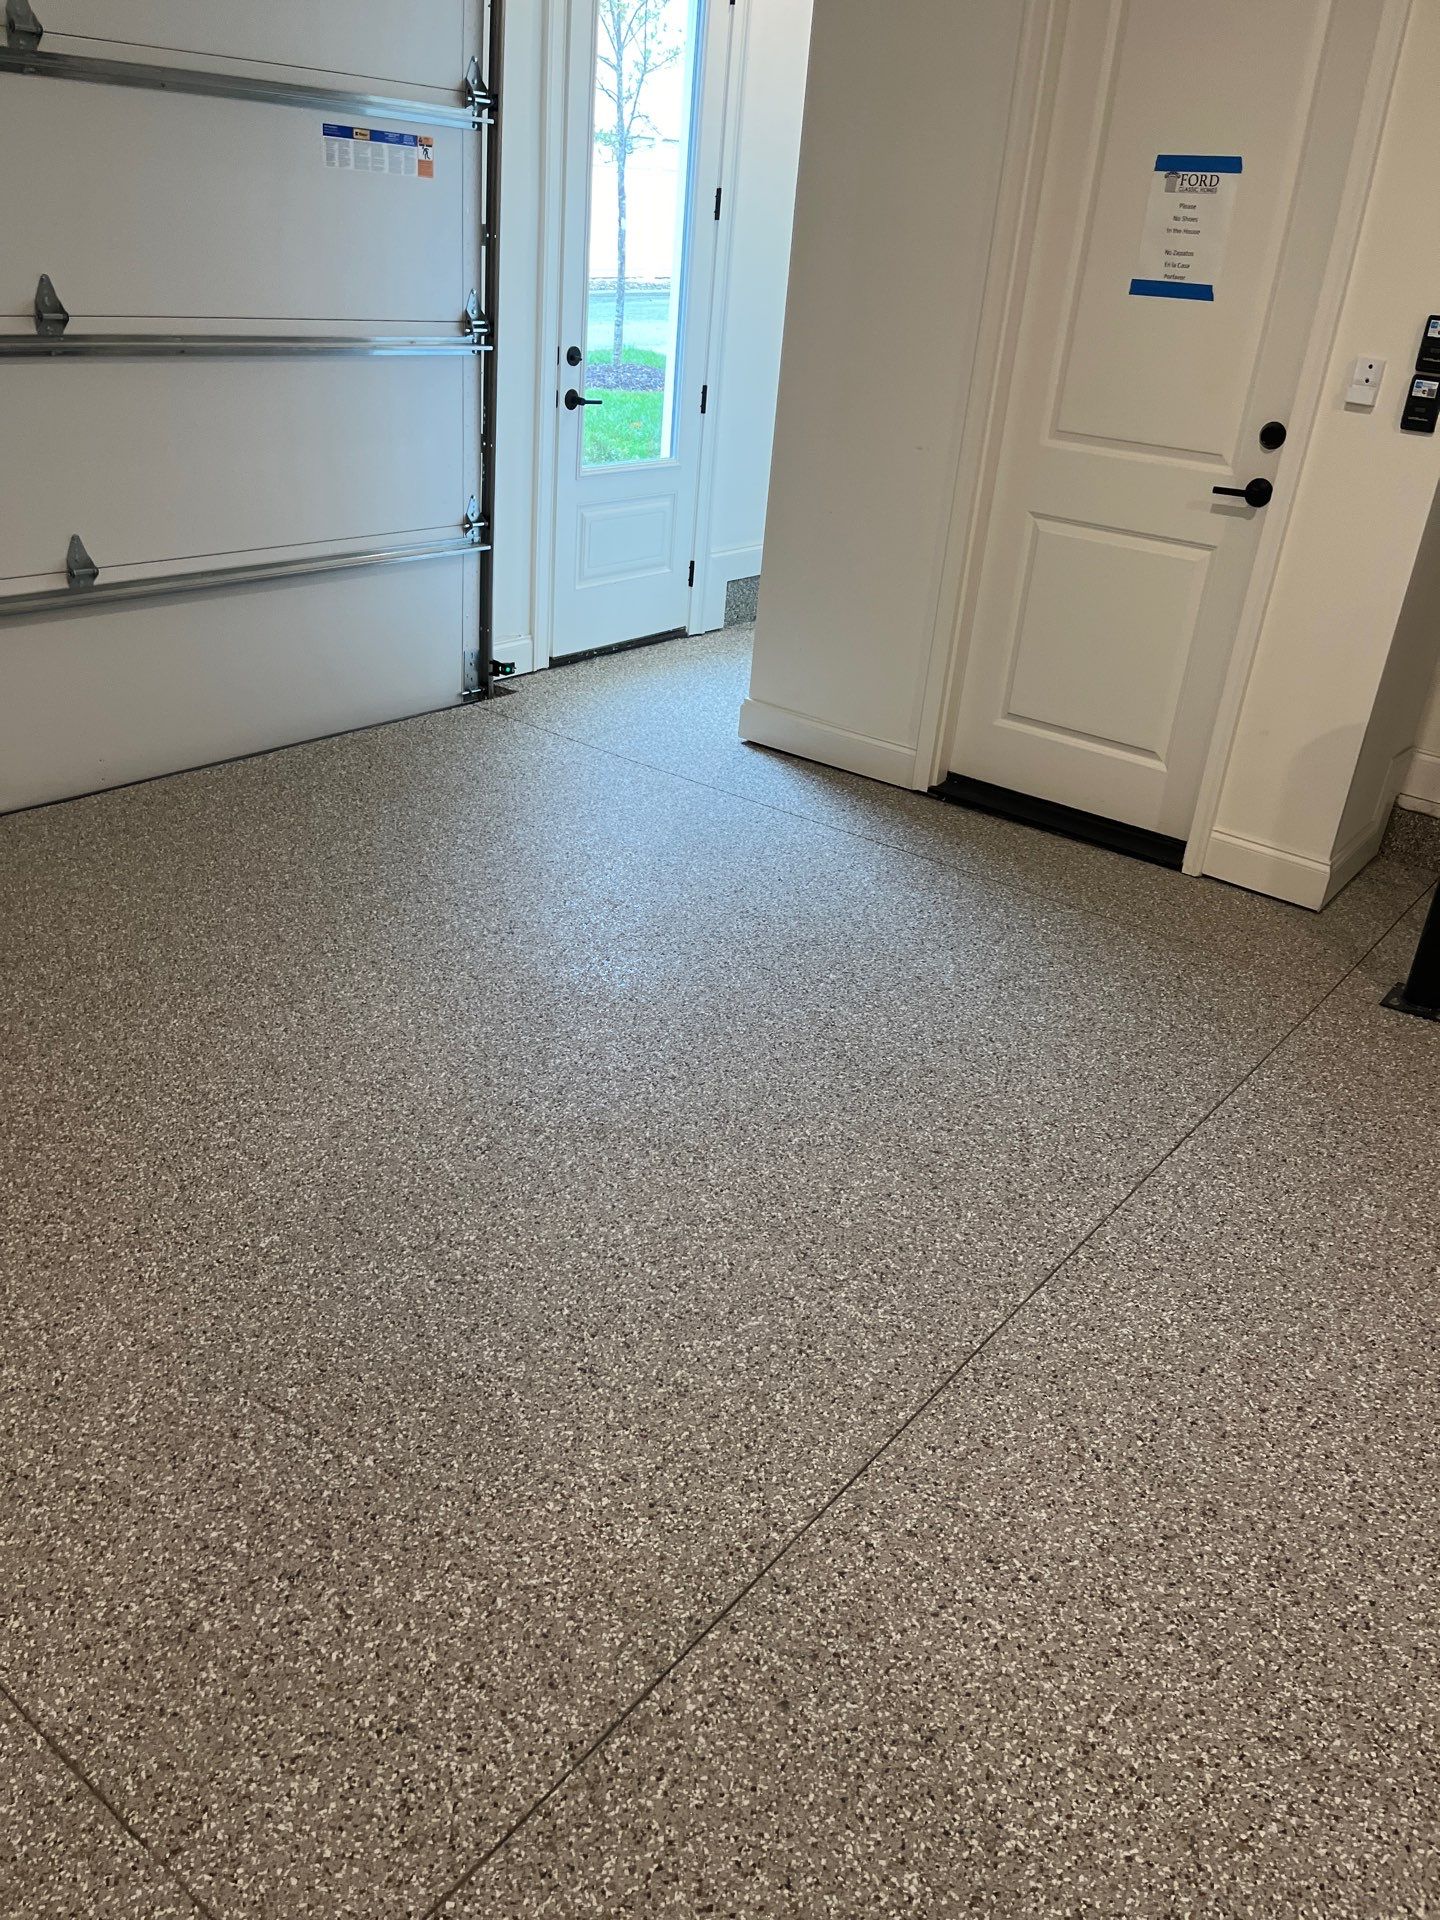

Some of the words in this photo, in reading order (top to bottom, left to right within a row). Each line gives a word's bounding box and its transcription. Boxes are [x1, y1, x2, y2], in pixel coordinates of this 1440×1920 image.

[1180, 173, 1220, 187] FORD
[1179, 202, 1197, 210] Please
[1181, 215, 1199, 223] Shoes
[1172, 249, 1194, 257] Zapatos
